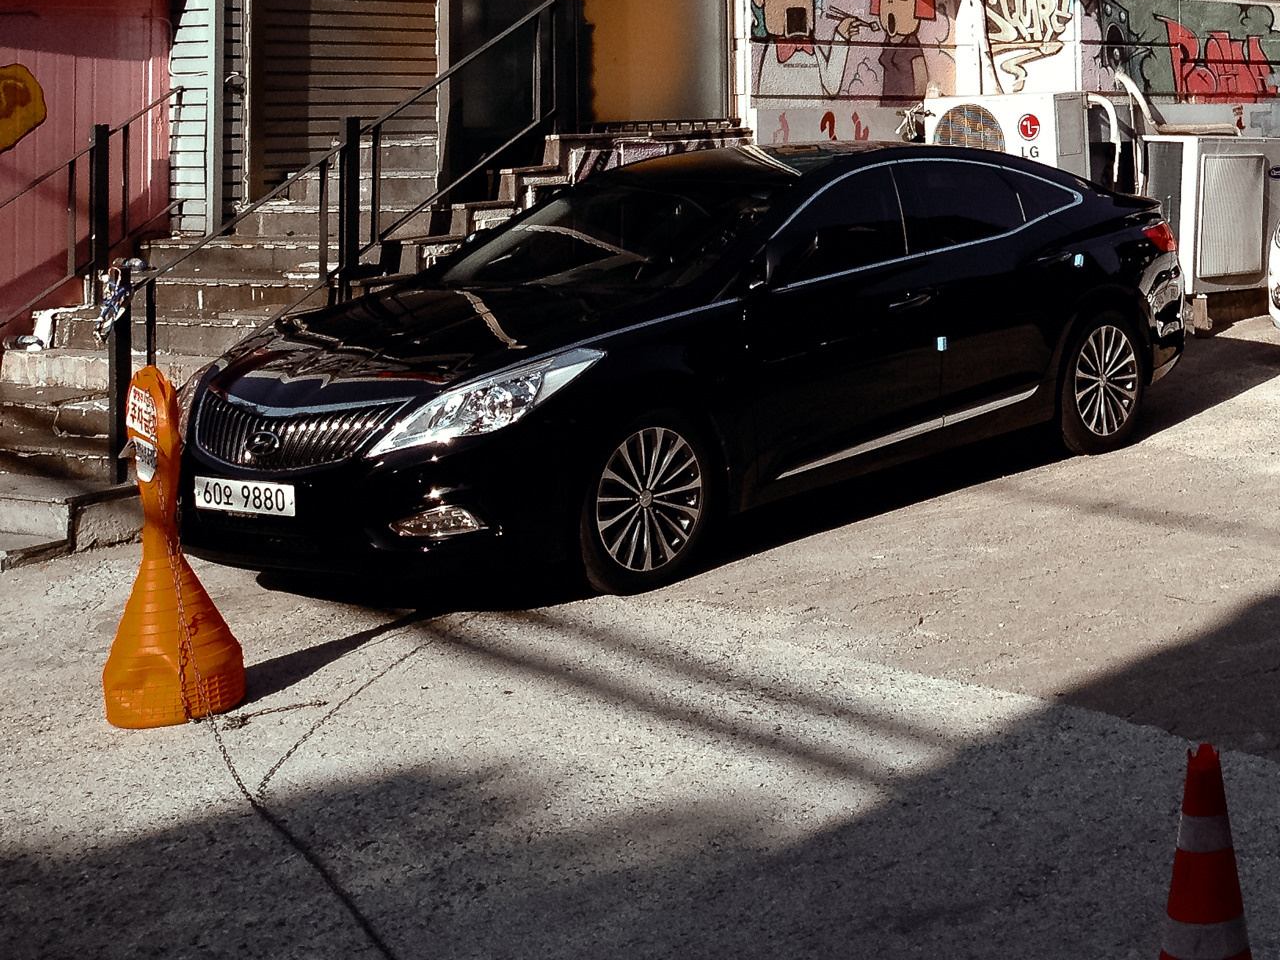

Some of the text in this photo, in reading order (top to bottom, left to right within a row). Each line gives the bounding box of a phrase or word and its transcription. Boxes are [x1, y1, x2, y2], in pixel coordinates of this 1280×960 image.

[1021, 146, 1040, 159] LG
[203, 481, 285, 512] 60오 9880
